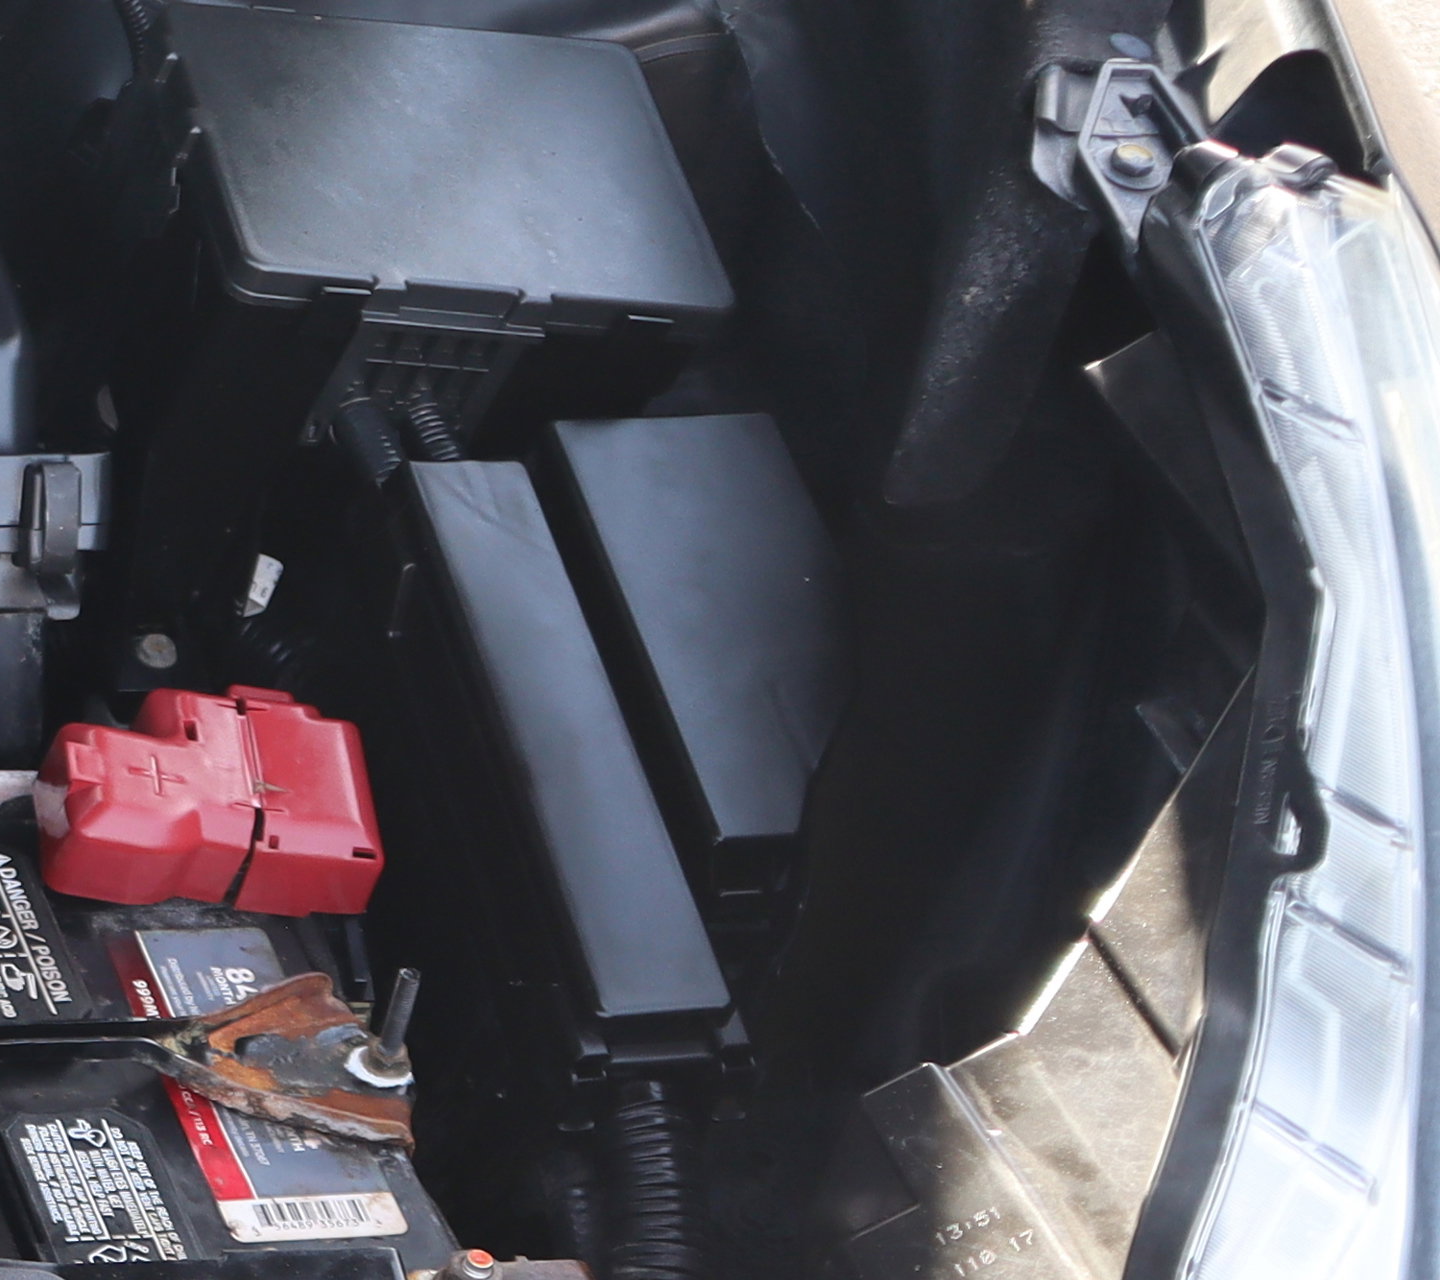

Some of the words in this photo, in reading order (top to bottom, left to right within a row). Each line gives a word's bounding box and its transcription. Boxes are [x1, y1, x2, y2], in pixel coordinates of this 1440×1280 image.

[31, 945, 72, 1002] POISON
[222, 965, 264, 1000] 84
[209, 965, 238, 1006] MONTH
[109, 1127, 124, 1139] DO
[114, 1140, 131, 1155] NOT
[125, 1141, 144, 1160] KEEP
[99, 1148, 121, 1171] FLUSH
[134, 1161, 152, 1177] OUT
[73, 1149, 97, 1179] MEDICAL
[86, 1179, 106, 1198] HELP
[87, 1150, 105, 1166] WITH
[106, 1194, 125, 1208] GET
[110, 1171, 129, 1189] EYES
[142, 1178, 158, 1189] OF
[148, 1190, 164, 1205] THE
[118, 1191, 149, 1234] IMMEDIATELY
[155, 1206, 176, 1231] REACH
[166, 1232, 182, 1243] OF
